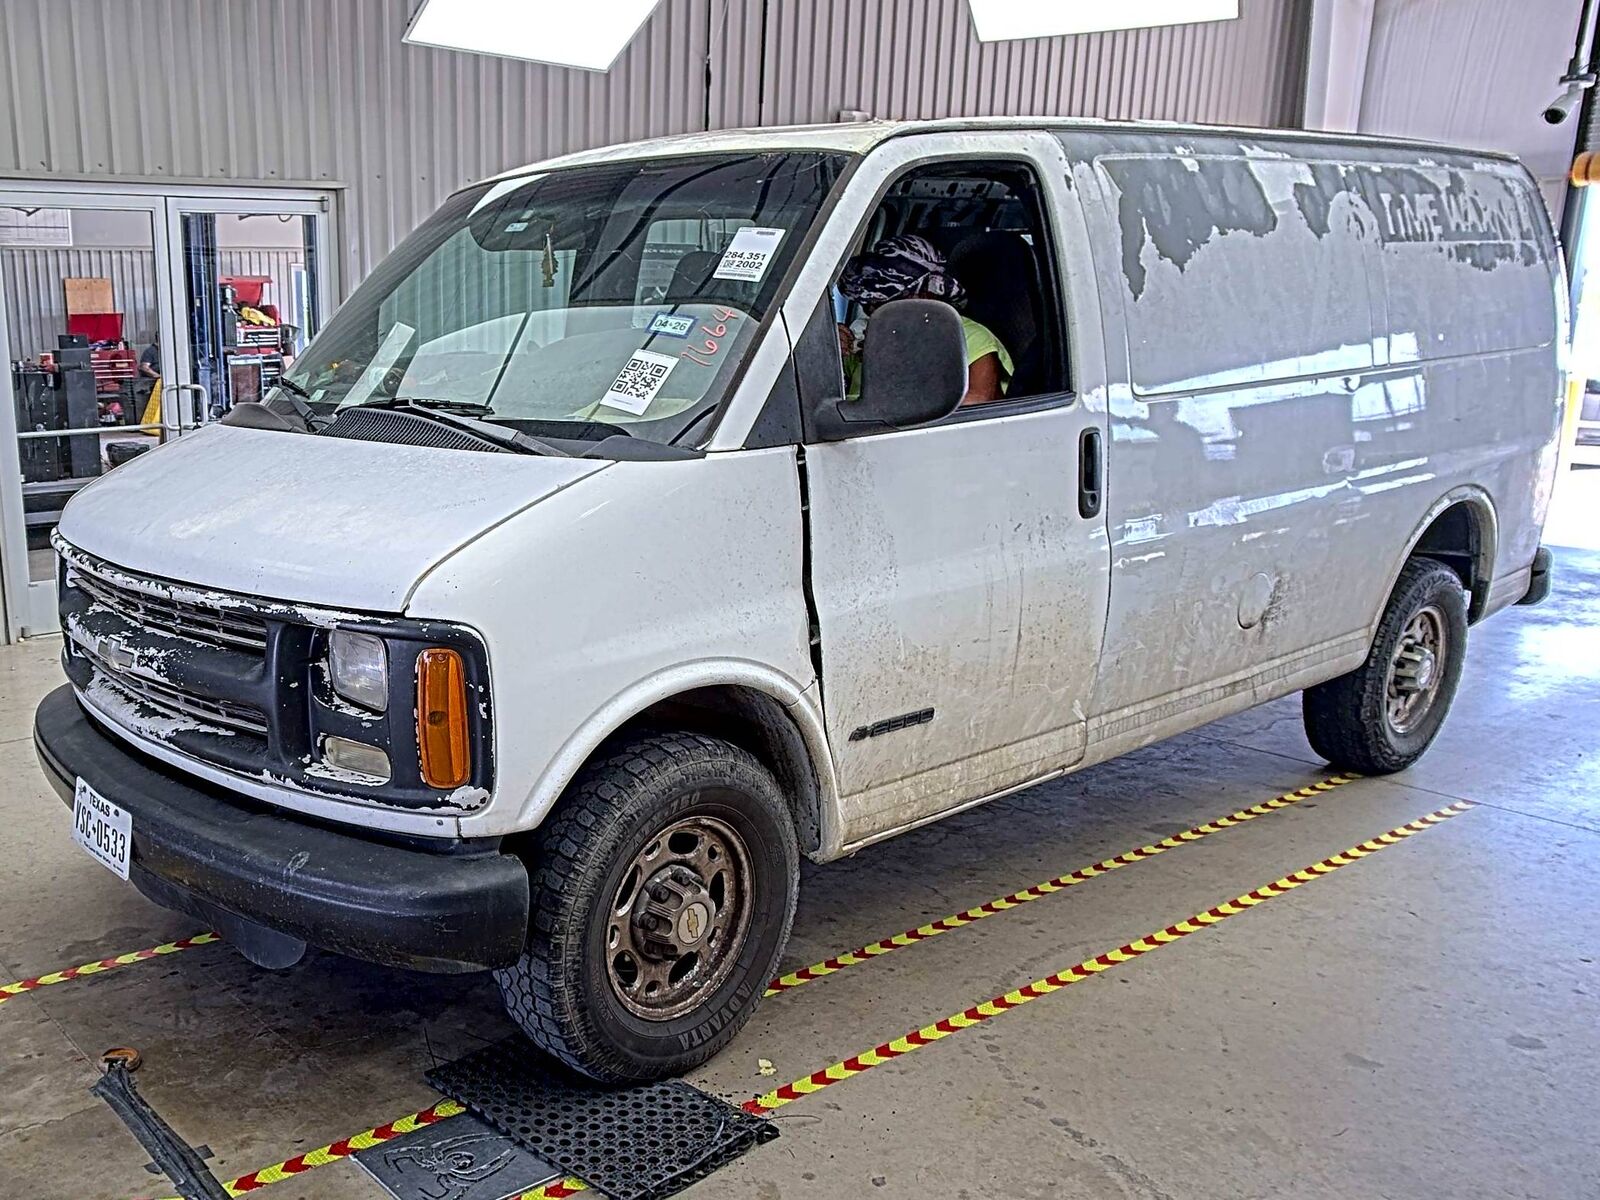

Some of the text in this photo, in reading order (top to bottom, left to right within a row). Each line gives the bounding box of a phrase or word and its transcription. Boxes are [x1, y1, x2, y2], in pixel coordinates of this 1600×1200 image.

[724, 250, 767, 261] 284,351
[735, 260, 763, 270] 2002
[654, 319, 688, 331] 04 26
[88, 791, 111, 817] TEXAS
[678, 979, 753, 1051] ADVANTA
